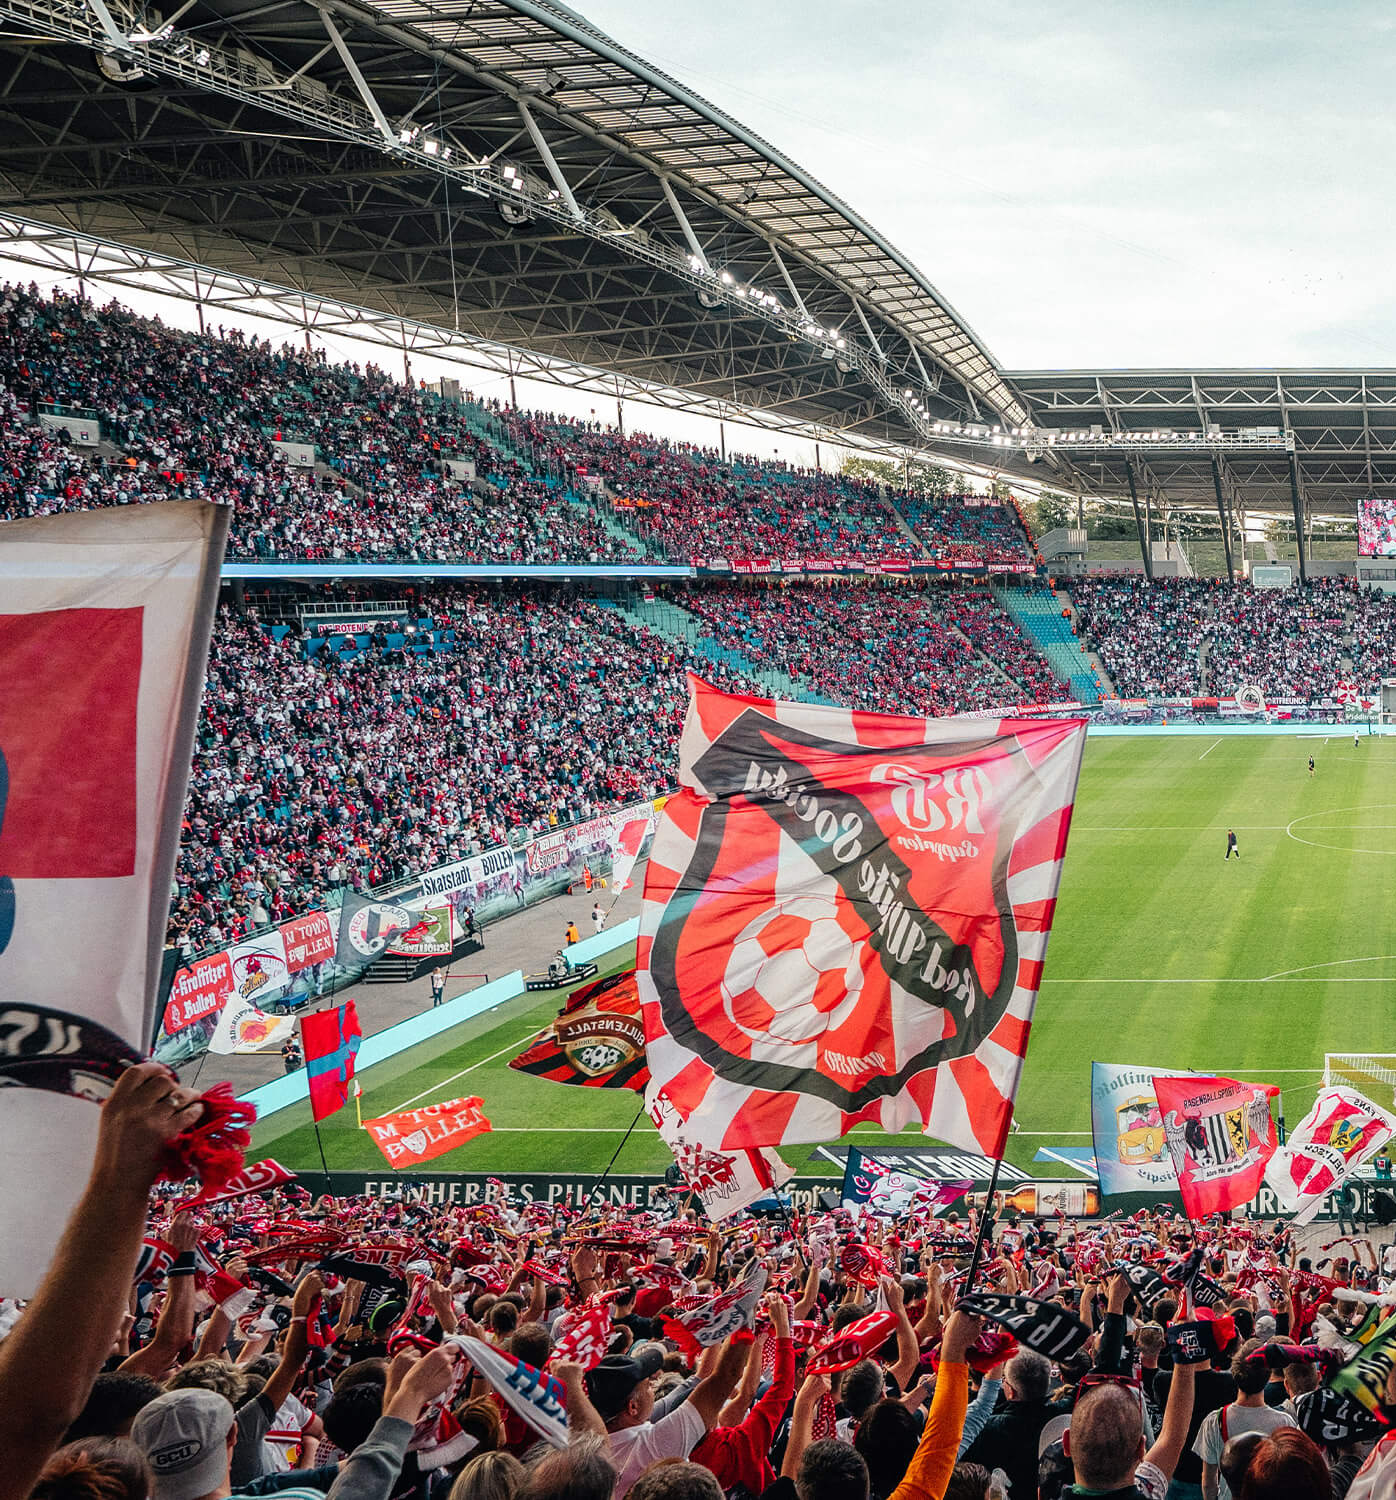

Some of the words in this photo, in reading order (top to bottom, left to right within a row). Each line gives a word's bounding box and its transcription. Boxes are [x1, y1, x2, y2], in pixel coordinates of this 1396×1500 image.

[423, 866, 472, 896] Skatstadt
[481, 850, 514, 874] BULLEN
[351, 911, 367, 933] RED
[549, 1182, 657, 1207] PILSNE
[155, 1444, 192, 1467] GCU
